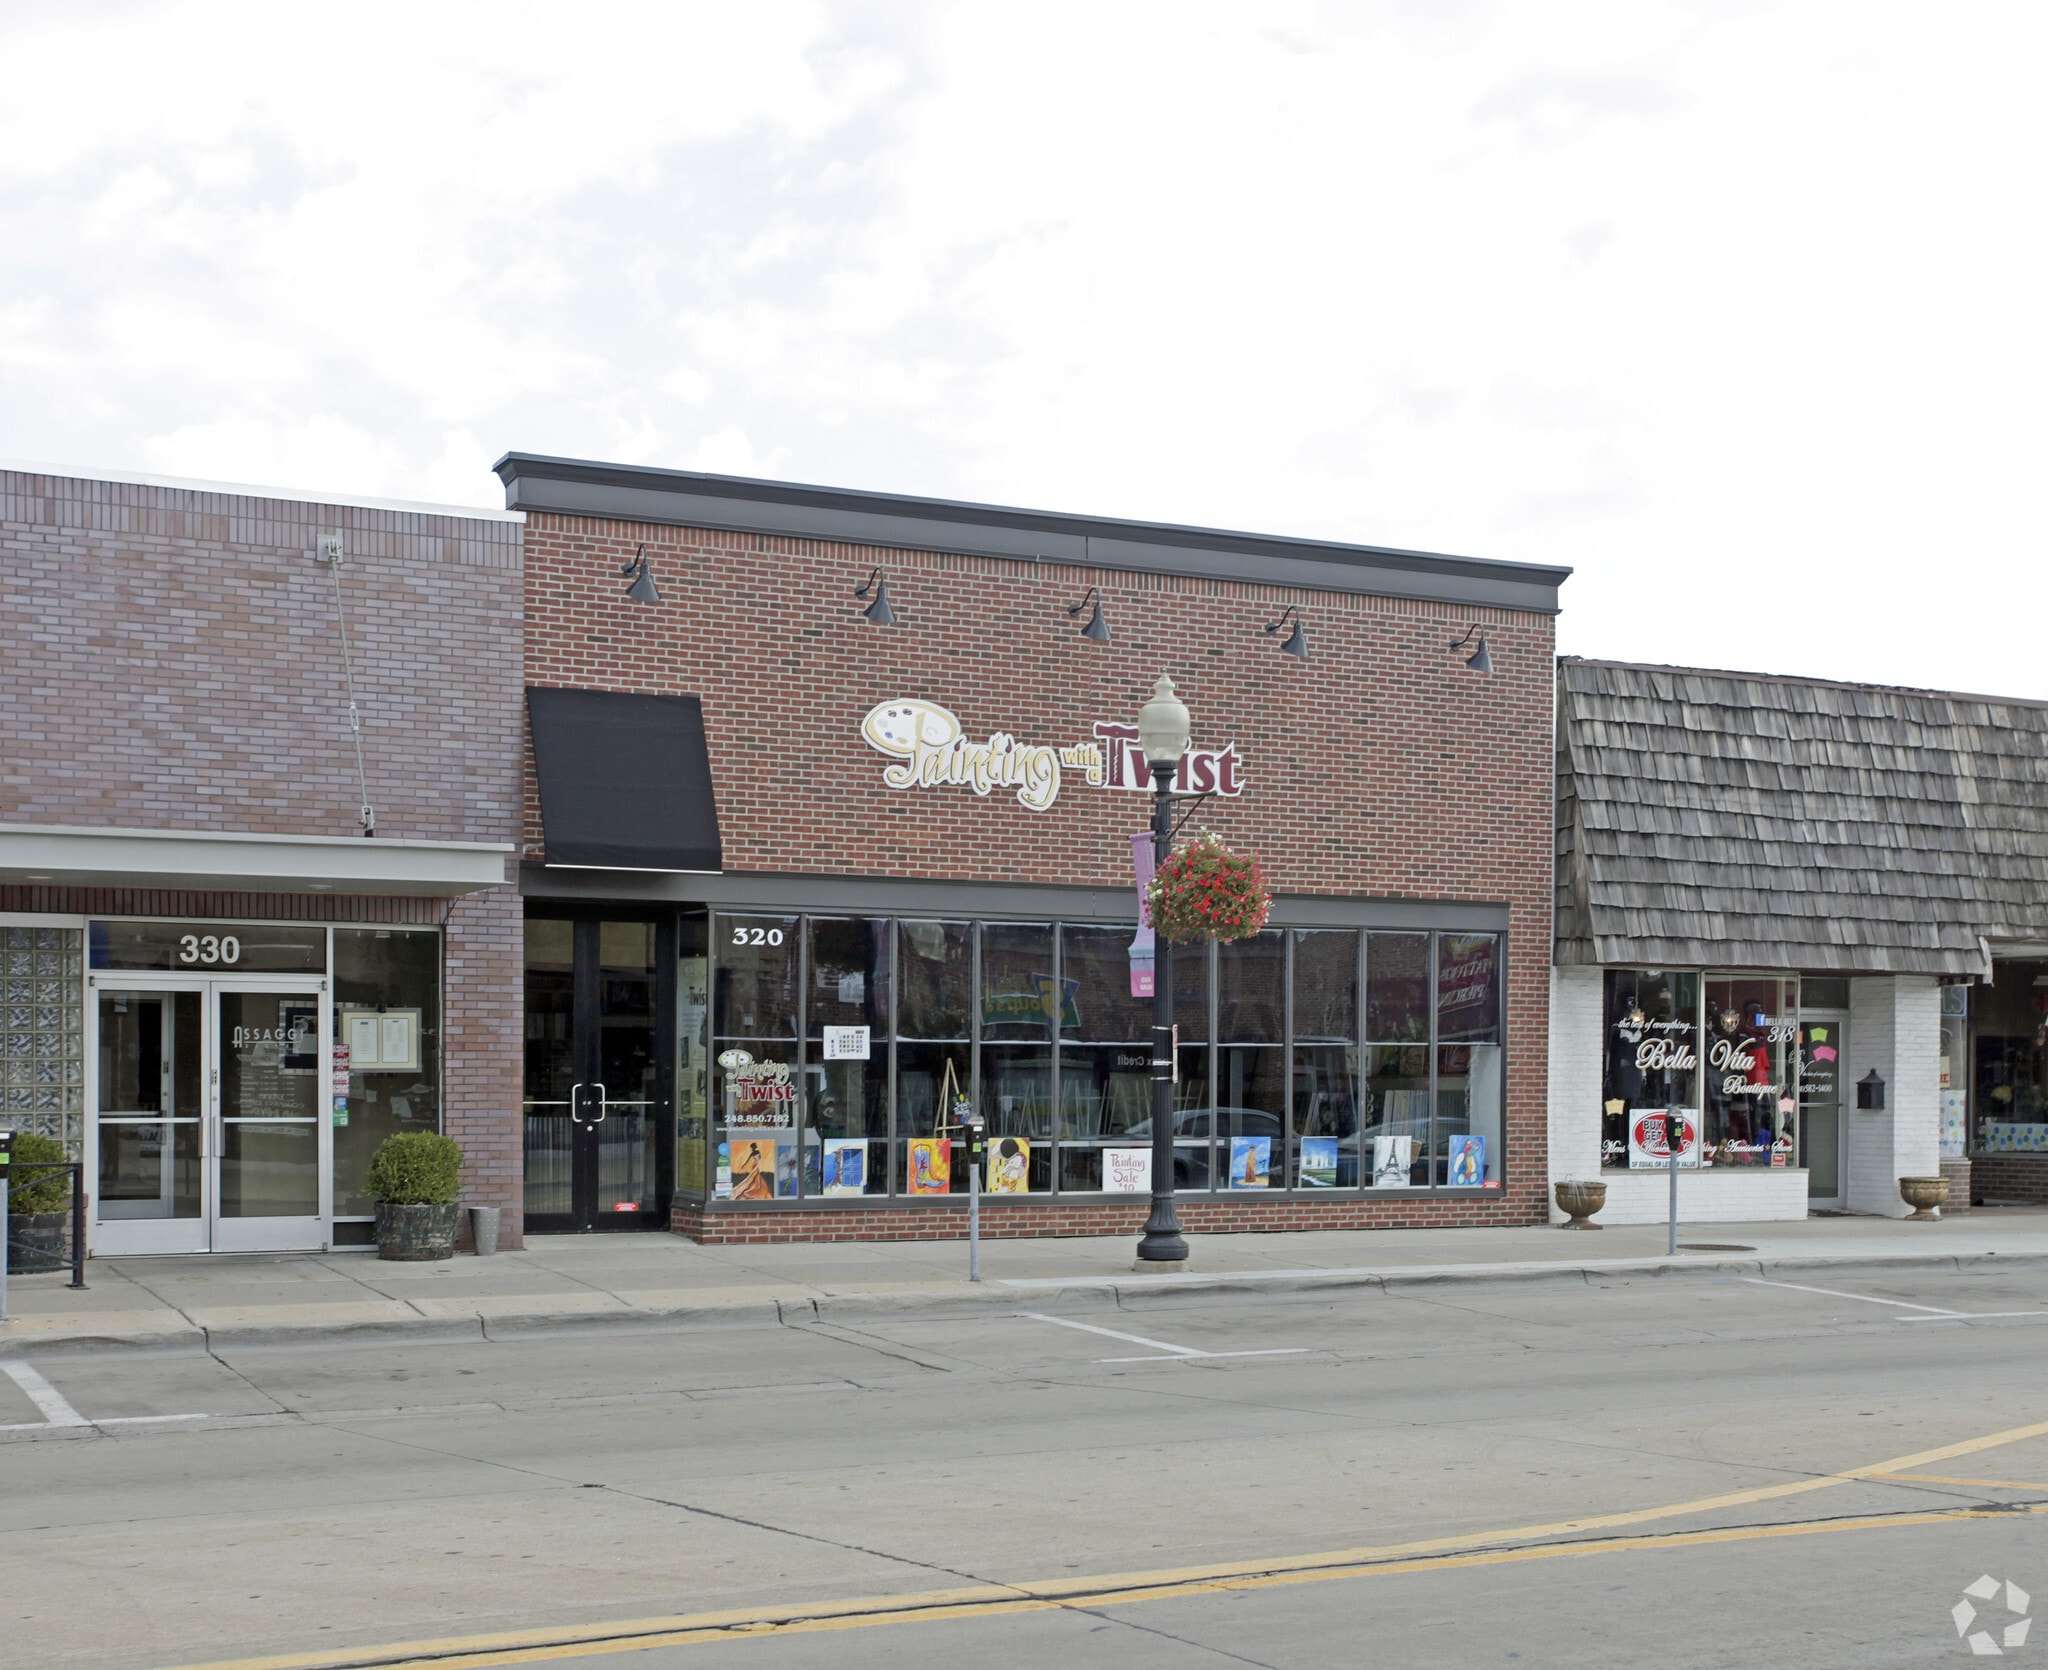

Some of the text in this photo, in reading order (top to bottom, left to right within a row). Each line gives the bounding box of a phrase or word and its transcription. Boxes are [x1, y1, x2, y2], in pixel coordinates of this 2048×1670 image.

[864, 700, 1099, 808] Painting with
[1090, 768, 1099, 782] a
[732, 928, 783, 946] 320
[180, 935, 240, 964] 330
[1618, 1018, 1630, 1028] the
[1644, 1018, 1655, 1032] of
[1767, 1026, 1796, 1042] 318
[1635, 1038, 1756, 1072] Bella Vita
[718, 1050, 790, 1085] Painting
[737, 1078, 793, 1101] Twist
[1722, 1075, 1778, 1100] Boutique
[724, 1114, 789, 1123] 248.850.7182
[1643, 1120, 1663, 1130] BUY
[1644, 1131, 1663, 1141] GET
[1110, 1153, 1145, 1172] Painting
[1113, 1169, 1138, 1183] Sale
